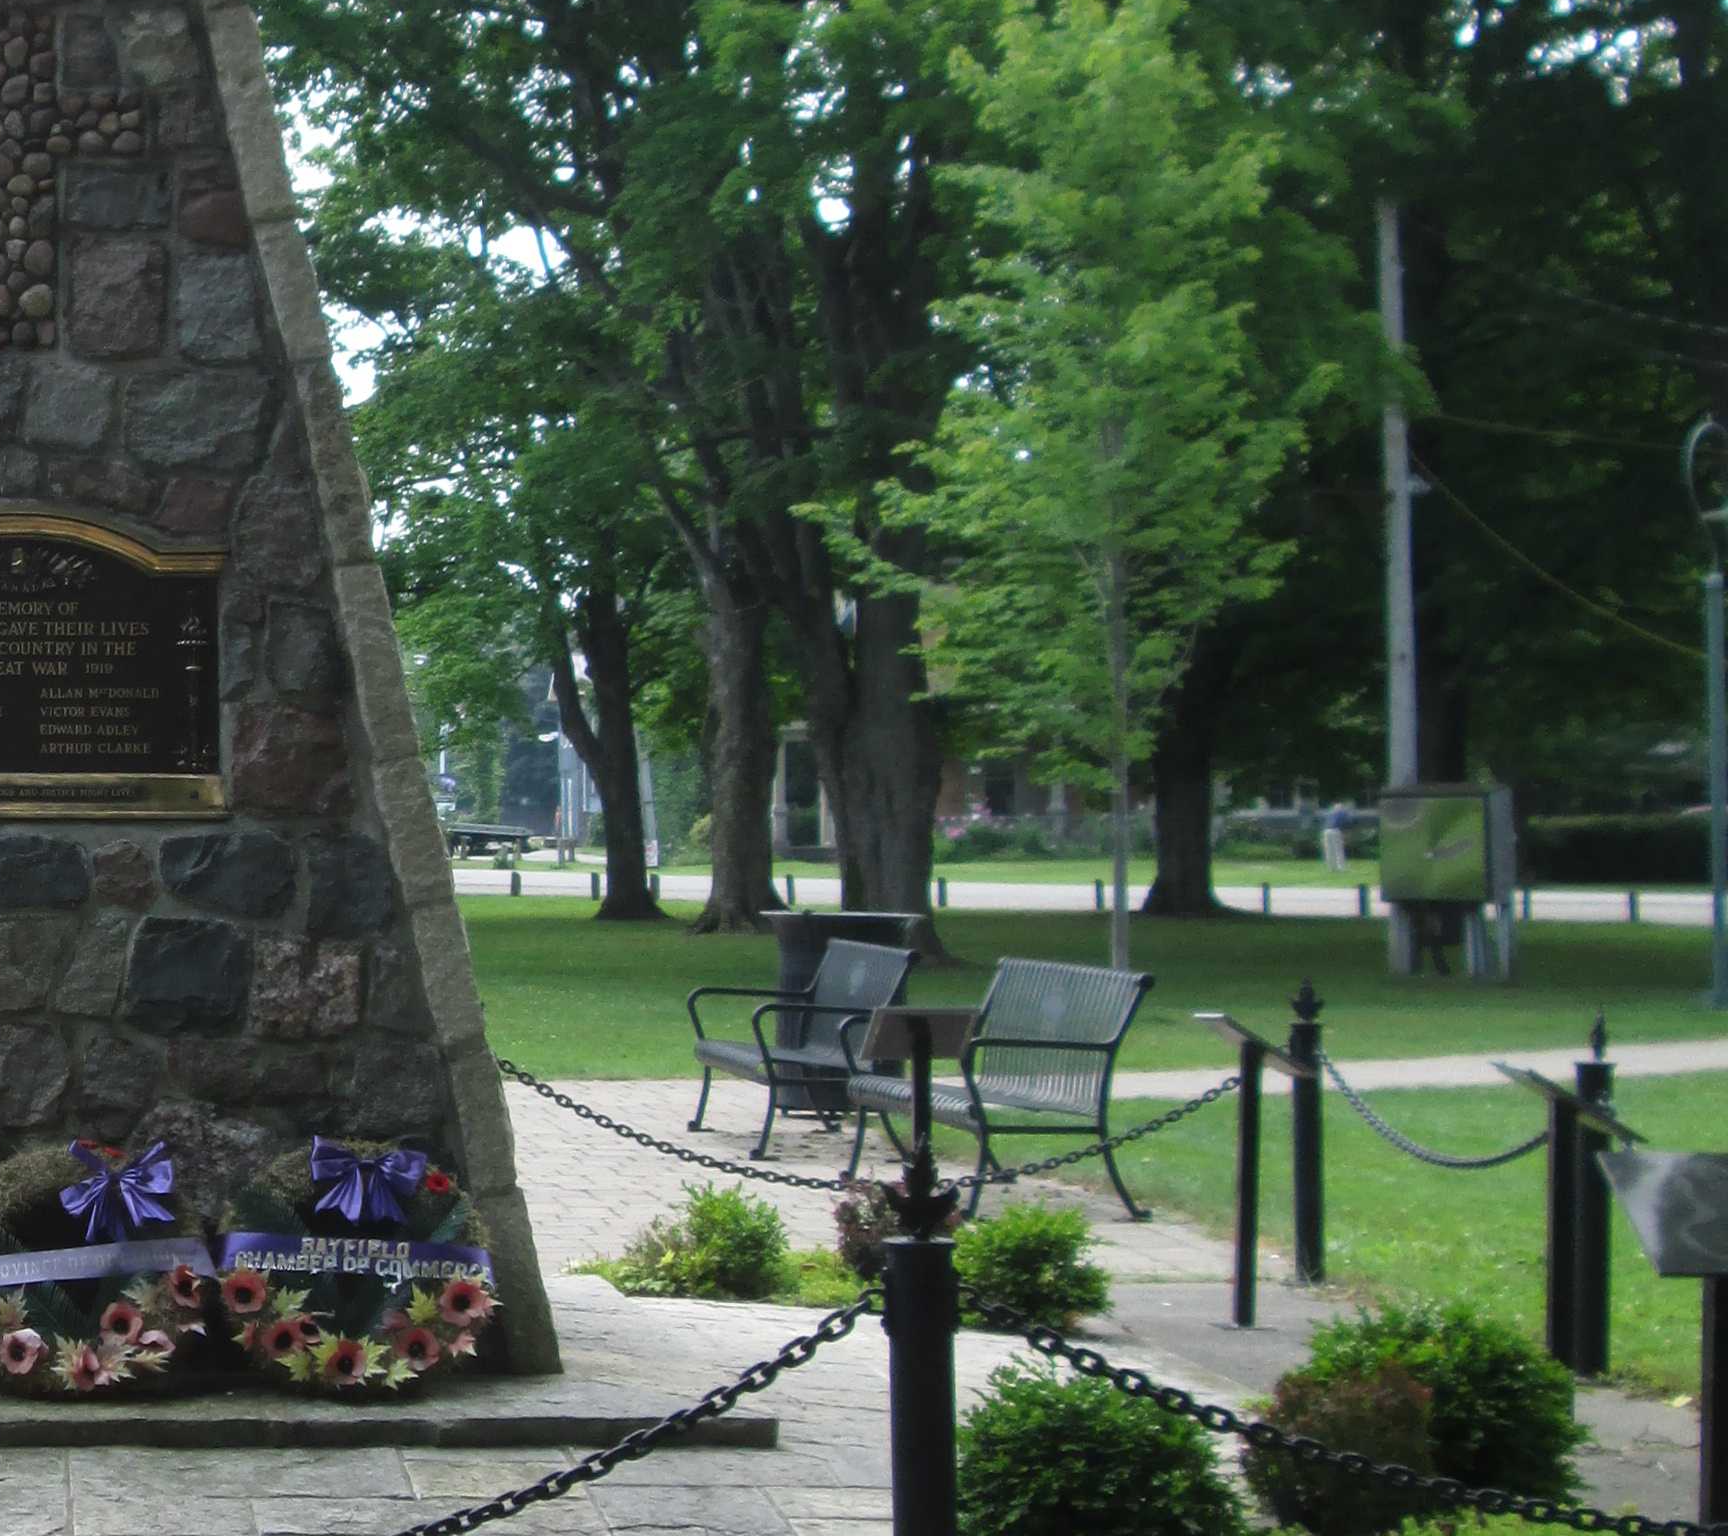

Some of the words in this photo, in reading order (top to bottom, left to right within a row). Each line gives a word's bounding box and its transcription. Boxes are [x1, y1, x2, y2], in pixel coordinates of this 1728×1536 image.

[57, 600, 79, 616] OF
[42, 620, 94, 636] THEIR
[100, 620, 149, 636] LIVES
[80, 640, 98, 656] IN
[103, 640, 137, 656] THE
[31, 661, 68, 676] WAR
[39, 686, 84, 699] ALLAN
[39, 705, 86, 718] VICTOR
[89, 705, 131, 718] EVANS
[39, 723, 92, 736] EDWARD
[39, 742, 92, 754] ARTHUR
[97, 742, 152, 754] CLARKE
[301, 1237, 411, 1260] BAYFIELD
[234, 1250, 339, 1275] CHAMBER
